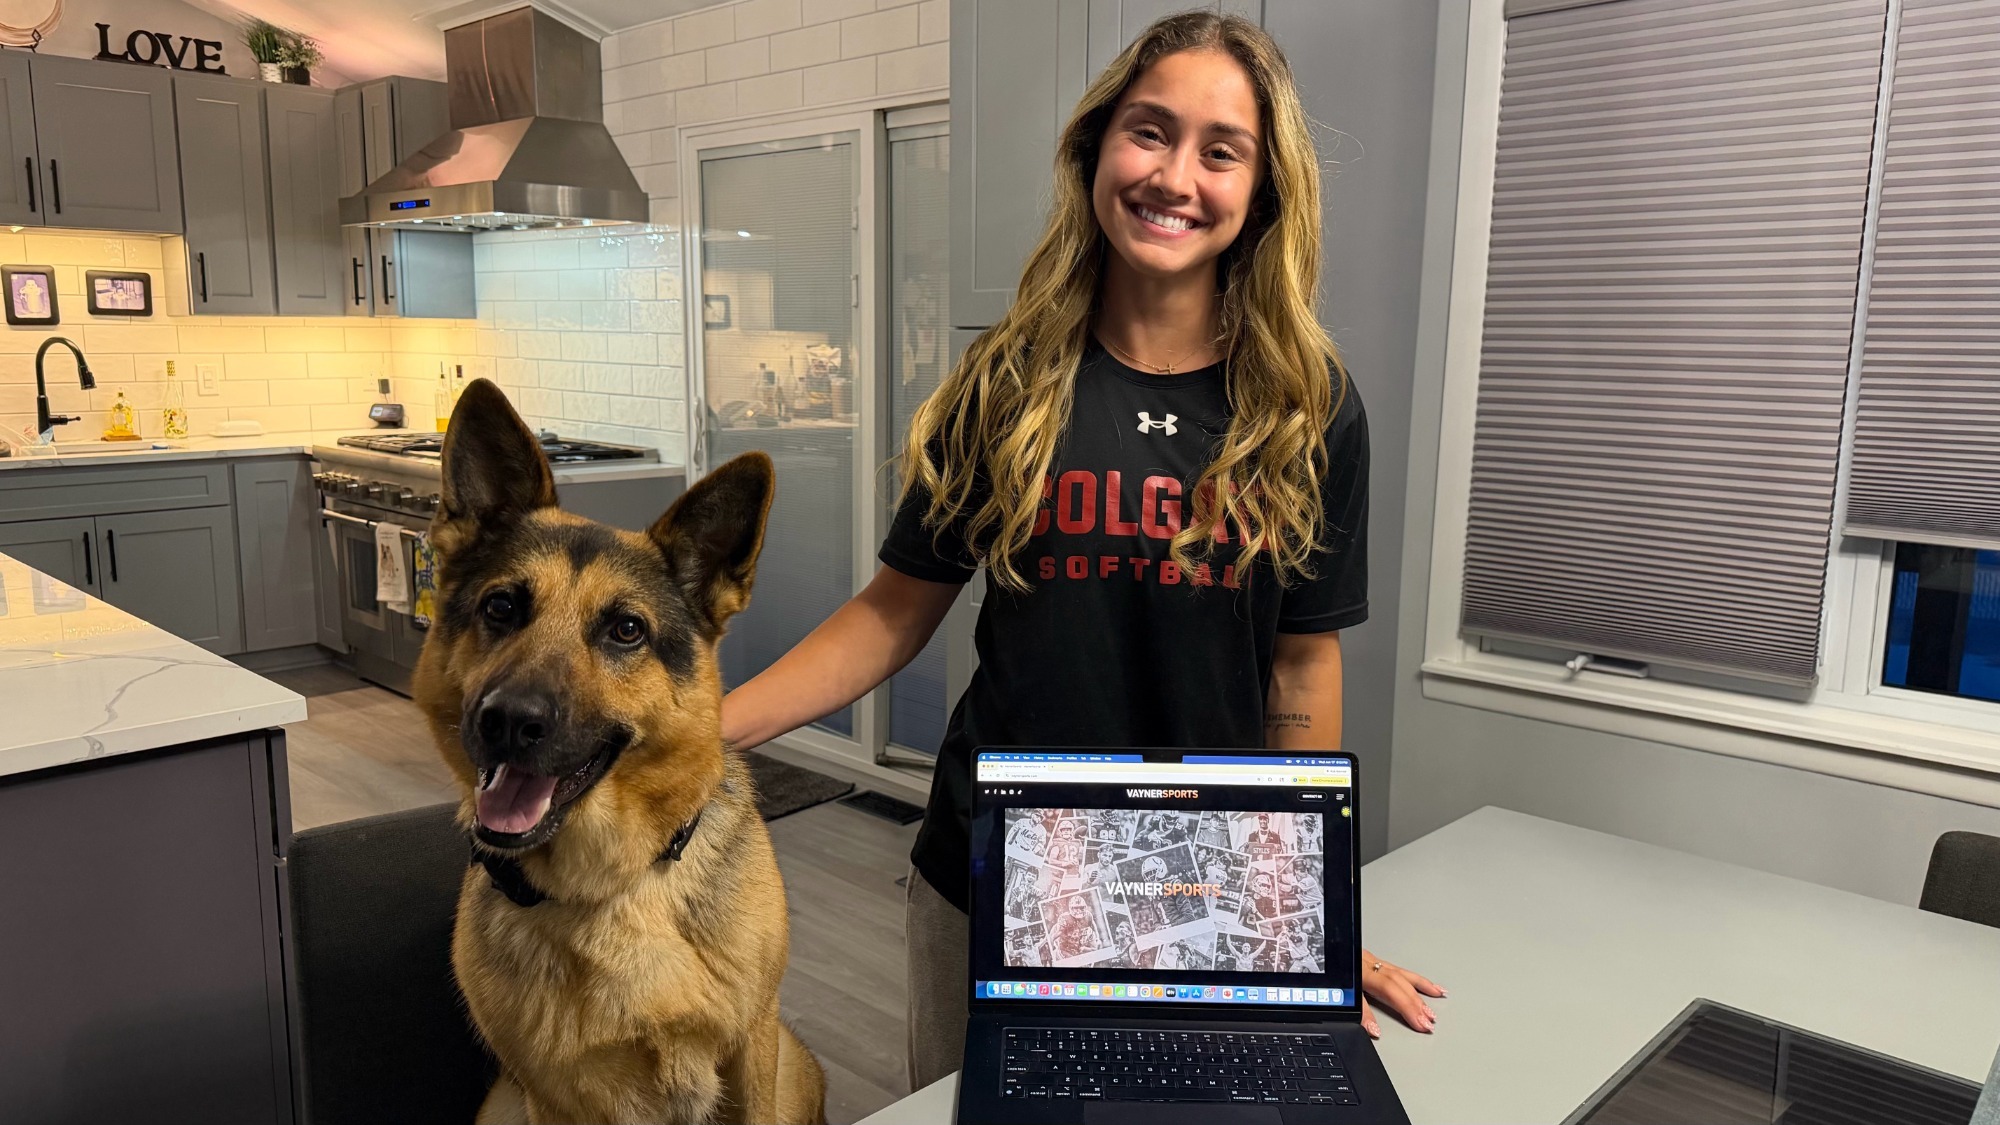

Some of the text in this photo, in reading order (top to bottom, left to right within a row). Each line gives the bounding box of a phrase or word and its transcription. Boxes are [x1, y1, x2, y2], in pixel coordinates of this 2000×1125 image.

[93, 22, 225, 74] LOVE
[1020, 470, 1283, 551] OLGA
[1038, 555, 1252, 589] SOFTBAL
[1265, 713, 1312, 722] EMEMBER
[1126, 788, 1198, 798] VAYNERSPORTS
[1105, 882, 1222, 898] VAYNERSPORTS
